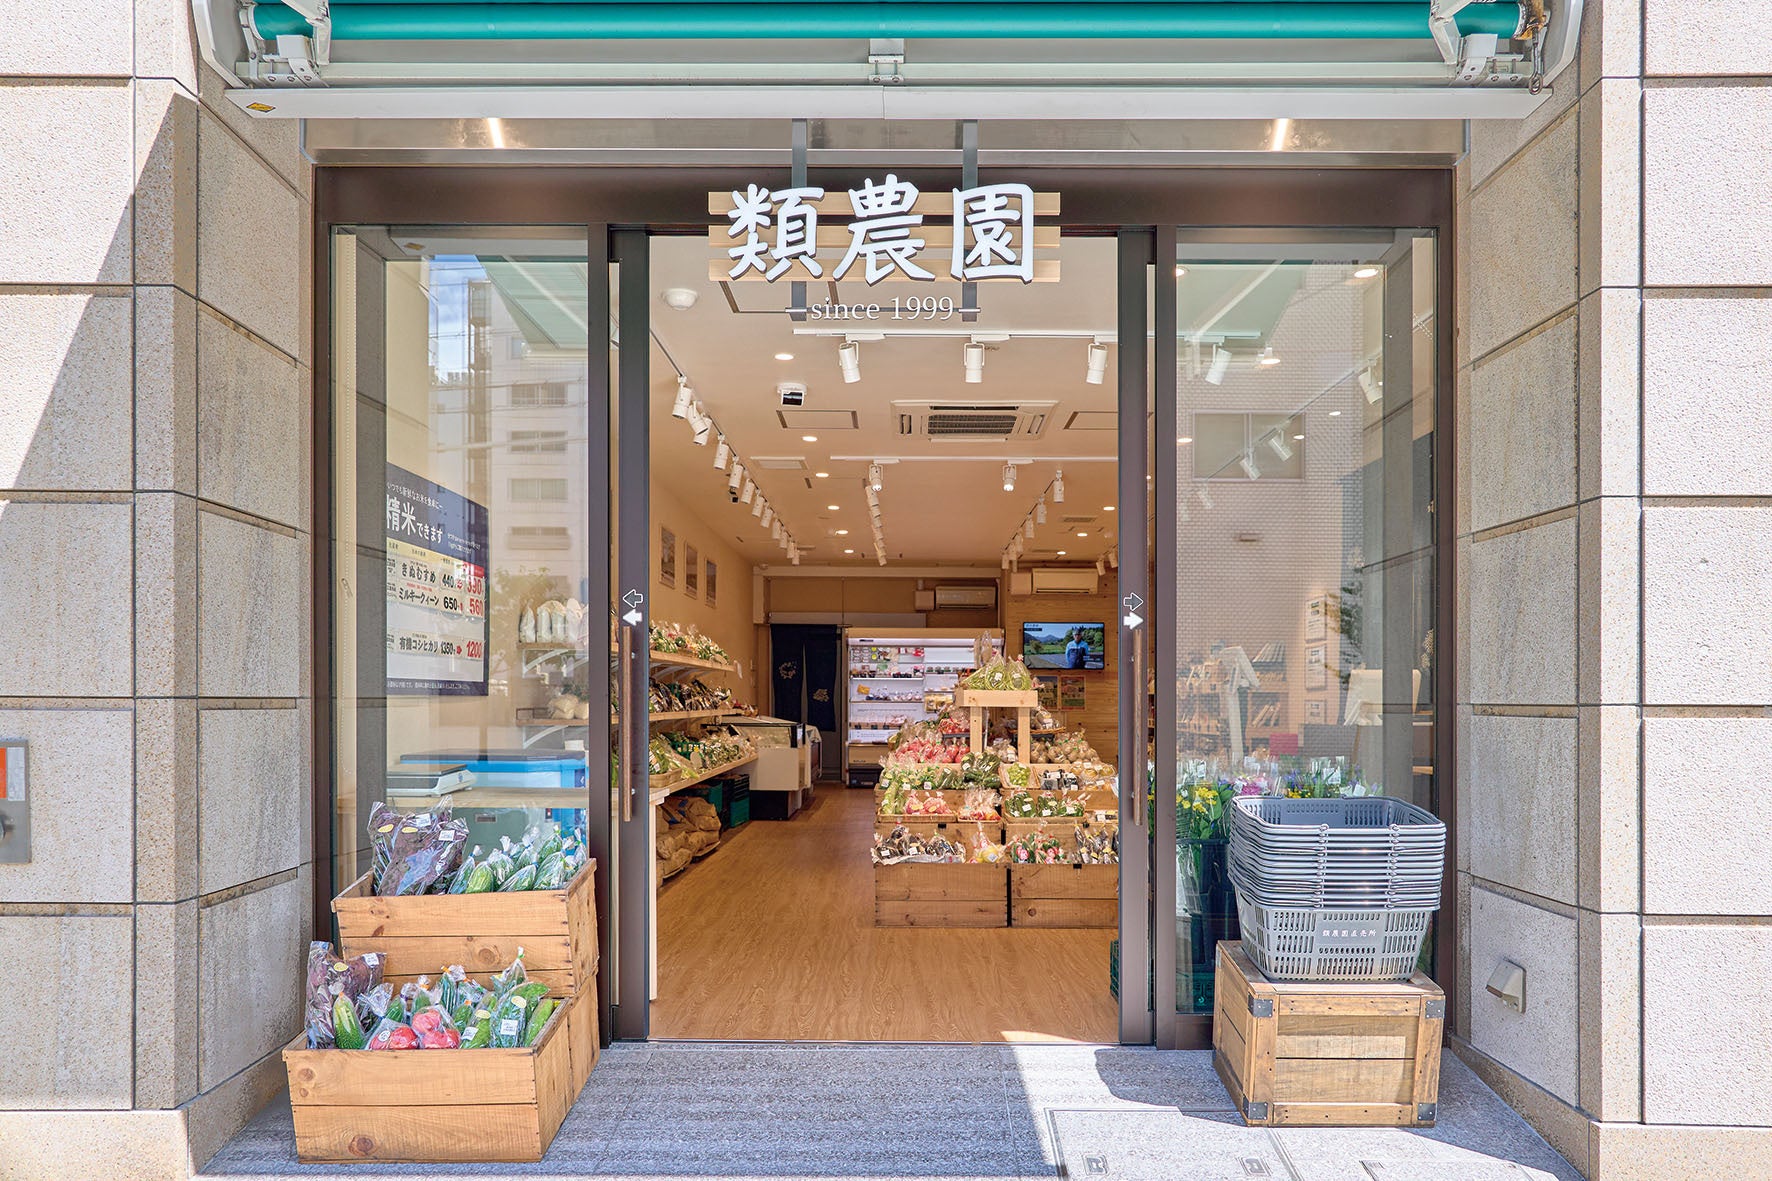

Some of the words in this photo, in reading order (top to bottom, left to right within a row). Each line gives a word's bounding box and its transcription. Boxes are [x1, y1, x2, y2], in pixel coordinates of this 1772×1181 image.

[727, 173, 1035, 286] 類農園
[811, 297, 880, 321] since
[890, 296, 954, 321] 1999
